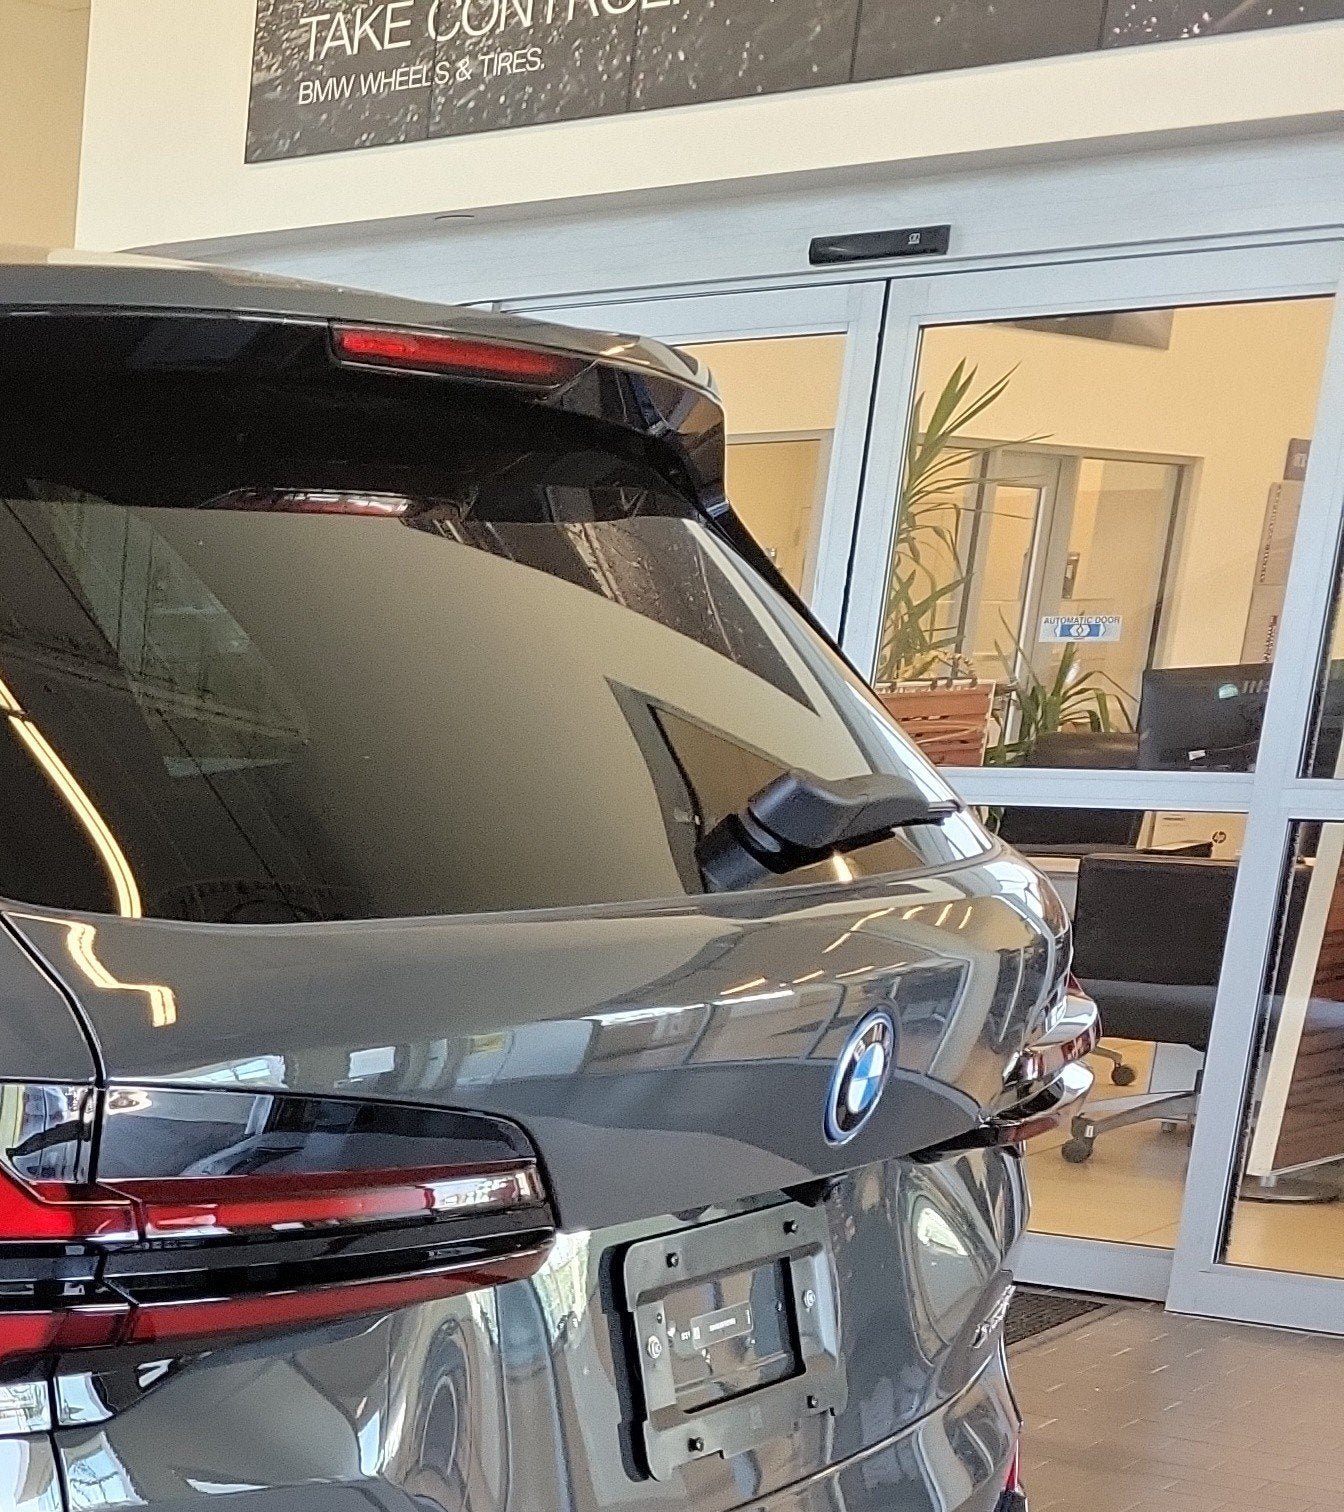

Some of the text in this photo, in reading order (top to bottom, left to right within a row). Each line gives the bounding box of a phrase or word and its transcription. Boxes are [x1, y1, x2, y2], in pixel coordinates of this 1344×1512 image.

[299, 2, 412, 62] TAKE
[298, 47, 545, 105] BMW WHEELS & TIRES.
[1043, 615, 1121, 625] AUTOMATIC DOOR
